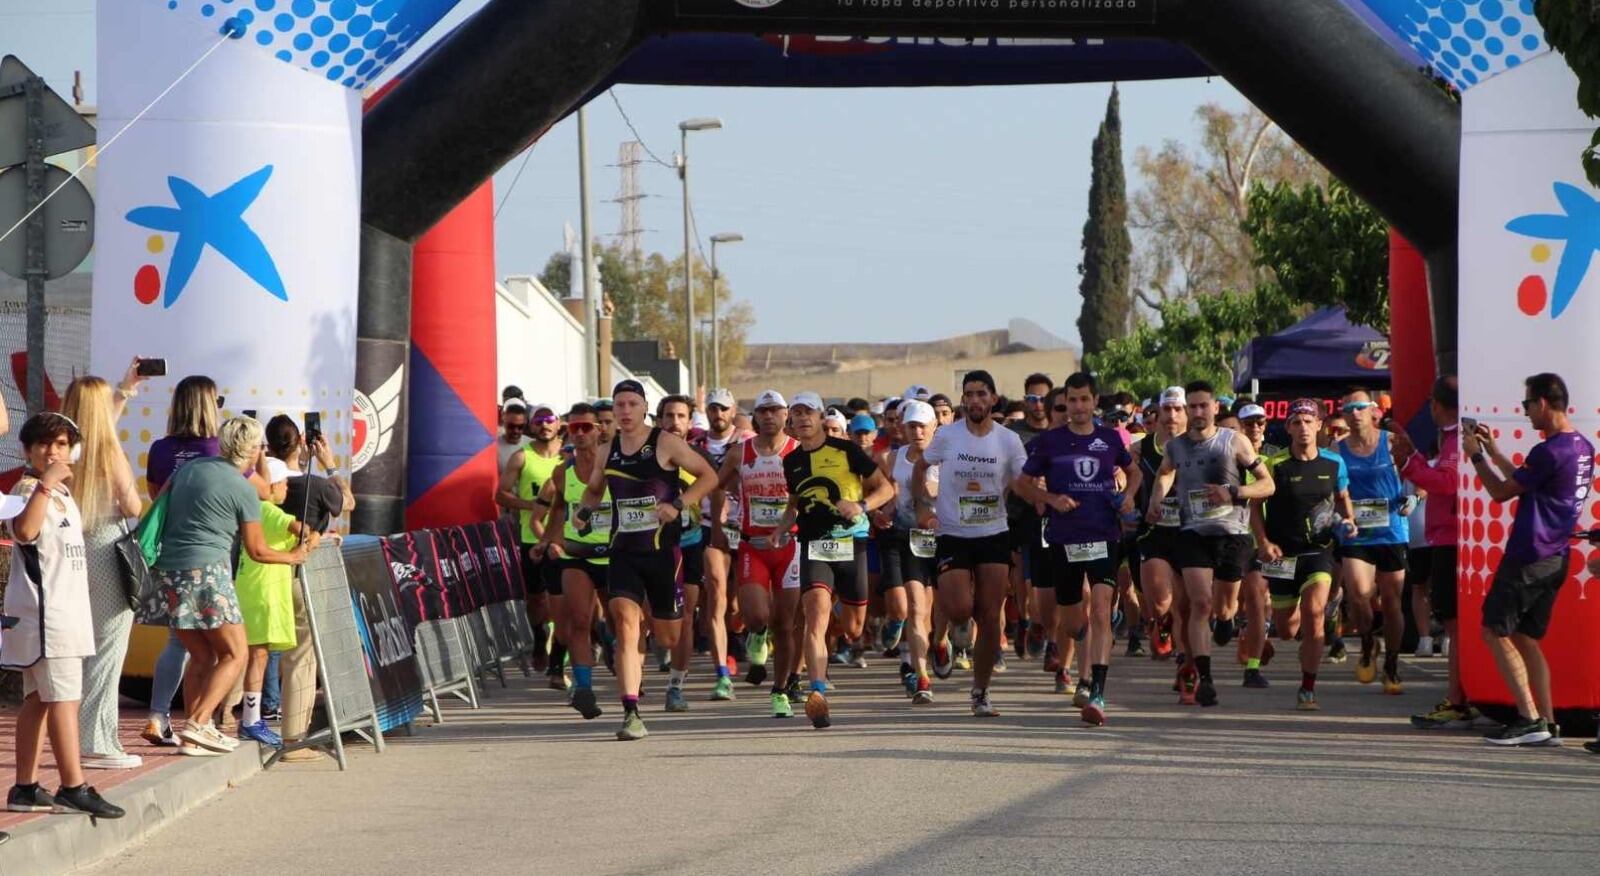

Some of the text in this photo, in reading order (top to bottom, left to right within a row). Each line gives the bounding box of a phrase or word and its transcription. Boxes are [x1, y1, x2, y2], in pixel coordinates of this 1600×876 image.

[862, 0, 902, 8] ropa
[1009, 0, 1136, 8] personalizada
[627, 510, 644, 520] 339
[761, 508, 778, 517] 237
[822, 542, 839, 551] 031
